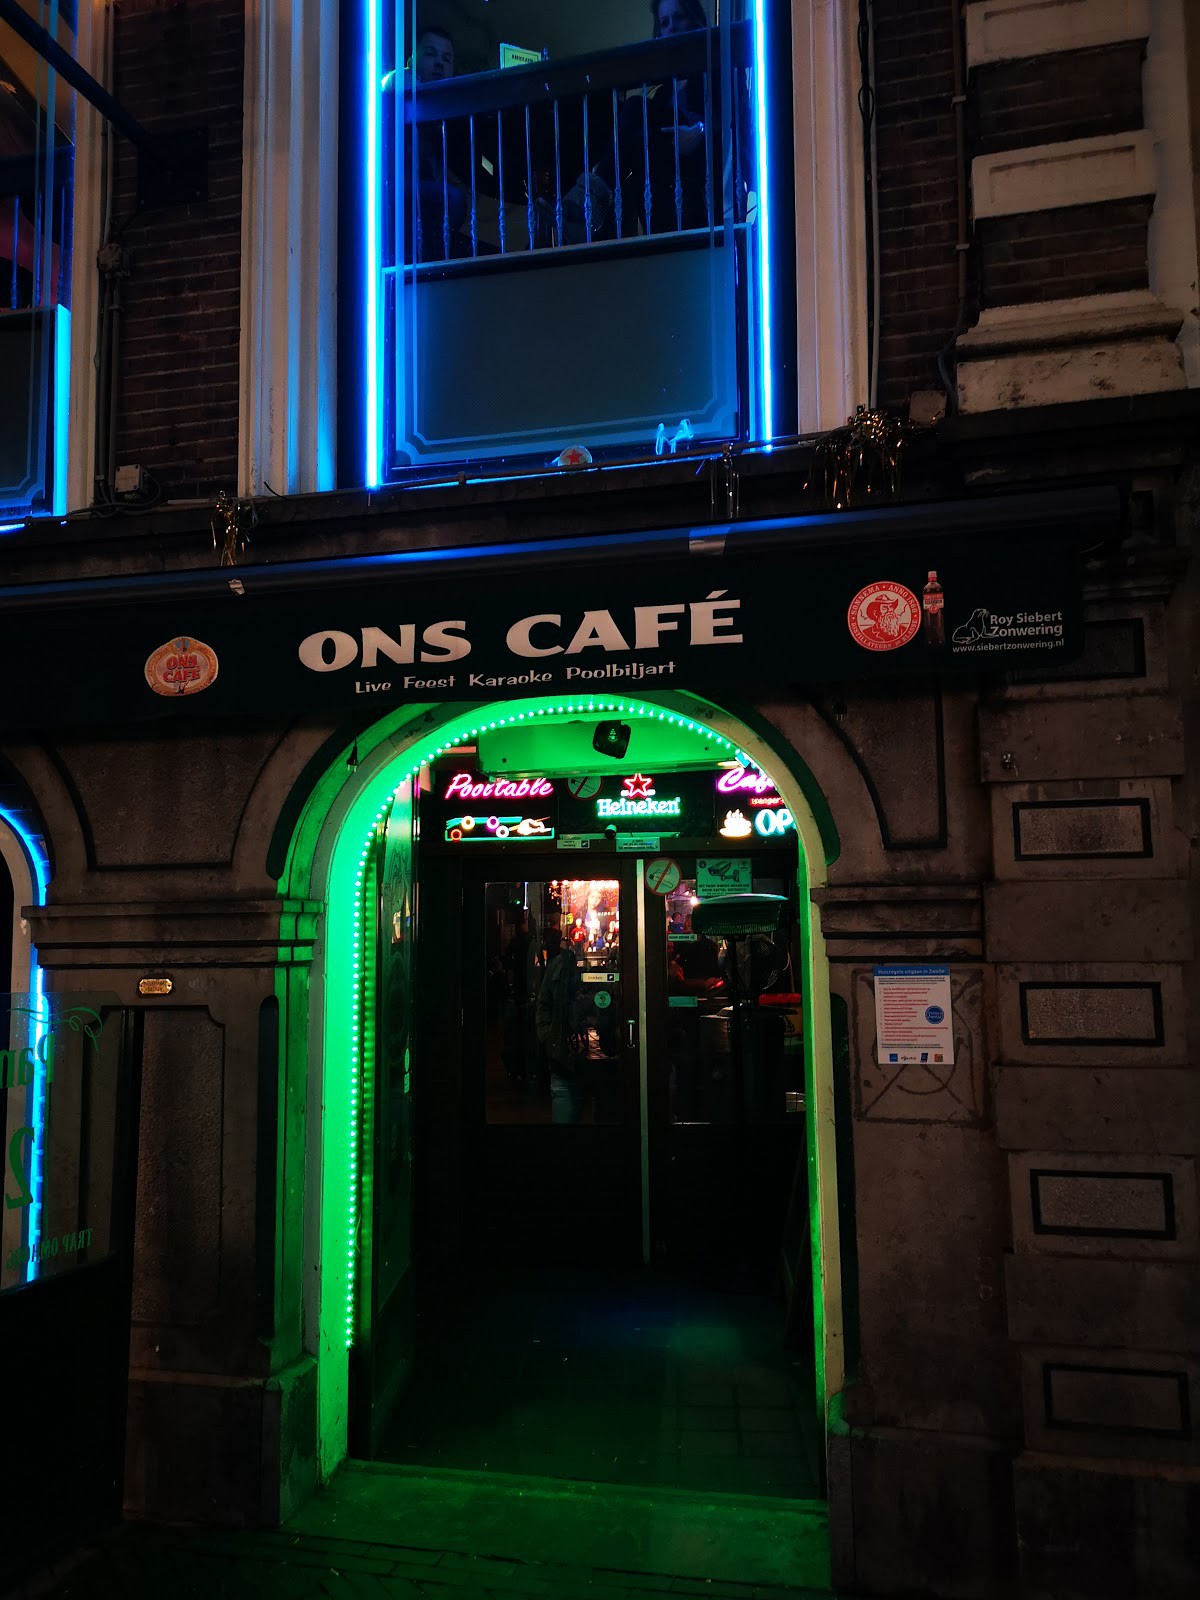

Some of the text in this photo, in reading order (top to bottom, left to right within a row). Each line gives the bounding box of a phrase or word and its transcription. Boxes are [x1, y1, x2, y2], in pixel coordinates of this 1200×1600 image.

[888, 585, 909, 598] ANNO
[990, 610, 1063, 626] Roy Siebert
[298, 588, 745, 673] ONS CAFÉ
[990, 623, 1063, 637] Zonwering
[952, 637, 1065, 653] www.siebertzonwering.nl
[166, 654, 198, 669] ONS
[355, 660, 677, 695] Live Feest Karaoke Poolbiljart
[597, 796, 681, 817] Heineken
[755, 809, 796, 836] OP
